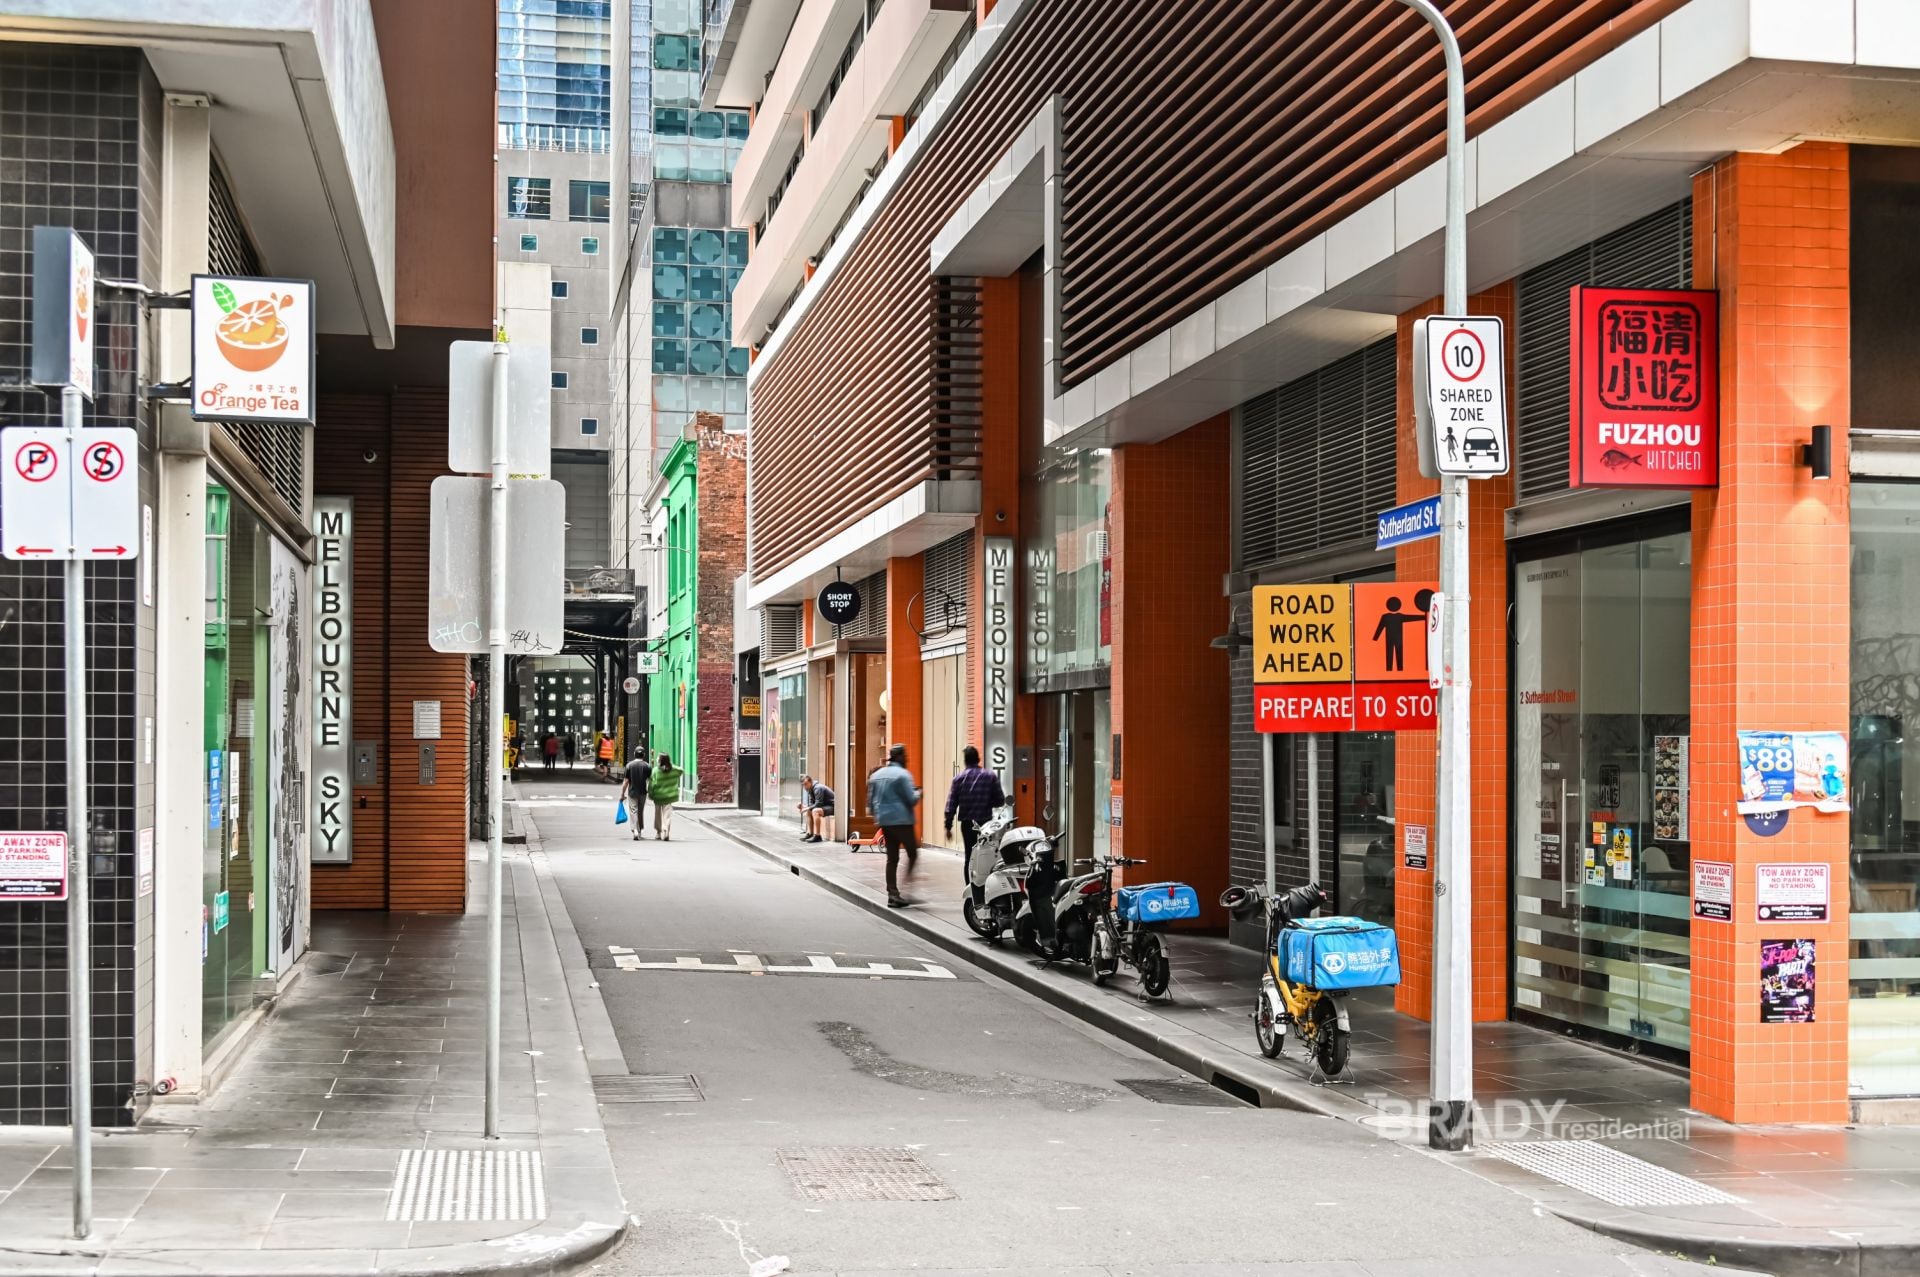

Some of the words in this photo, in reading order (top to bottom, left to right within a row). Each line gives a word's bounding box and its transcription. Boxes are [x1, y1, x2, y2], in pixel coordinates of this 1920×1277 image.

[1607, 309, 1694, 355] 福清
[1454, 345, 1474, 368] 10
[1607, 358, 1693, 403] 小吃
[201, 388, 267, 412] Orange
[270, 396, 300, 411] Tea
[1440, 388, 1493, 402] SHARED
[1450, 407, 1485, 421] ZONE
[1598, 422, 1701, 446] FUZHOU
[29, 450, 48, 473] P
[1647, 450, 1701, 471] KITCHEN
[1378, 508, 1423, 540] Sutherland
[1423, 506, 1434, 529] St
[827, 593, 852, 601] SHORT
[1270, 595, 1335, 615] ROAD
[319, 511, 344, 746] MELBOURNE
[991, 549, 1007, 725] MELBOURNE
[1269, 623, 1336, 644] WORK
[1262, 652, 1344, 673] AHEAD
[1260, 697, 1353, 719] PREPARE
[1362, 696, 1387, 718] TO
[1396, 695, 1438, 717] STO
[1519, 691, 1525, 705] 2
[1525, 689, 1557, 705] Sutherland
[1558, 688, 1577, 703] Street
[319, 775, 343, 853] SKY
[4, 838, 31, 847] AWAY
[35, 838, 62, 847] ZONE
[1696, 865, 1705, 874] TOW
[1706, 867, 1718, 875] AWAY
[1718, 868, 1730, 877] ZONE
[1761, 869, 1778, 877] TOW
[1780, 869, 1802, 877] AWAY
[1804, 869, 1825, 877] ZONE
[1768, 947, 1799, 965] K-POP
[1777, 959, 1809, 977] PARTY
